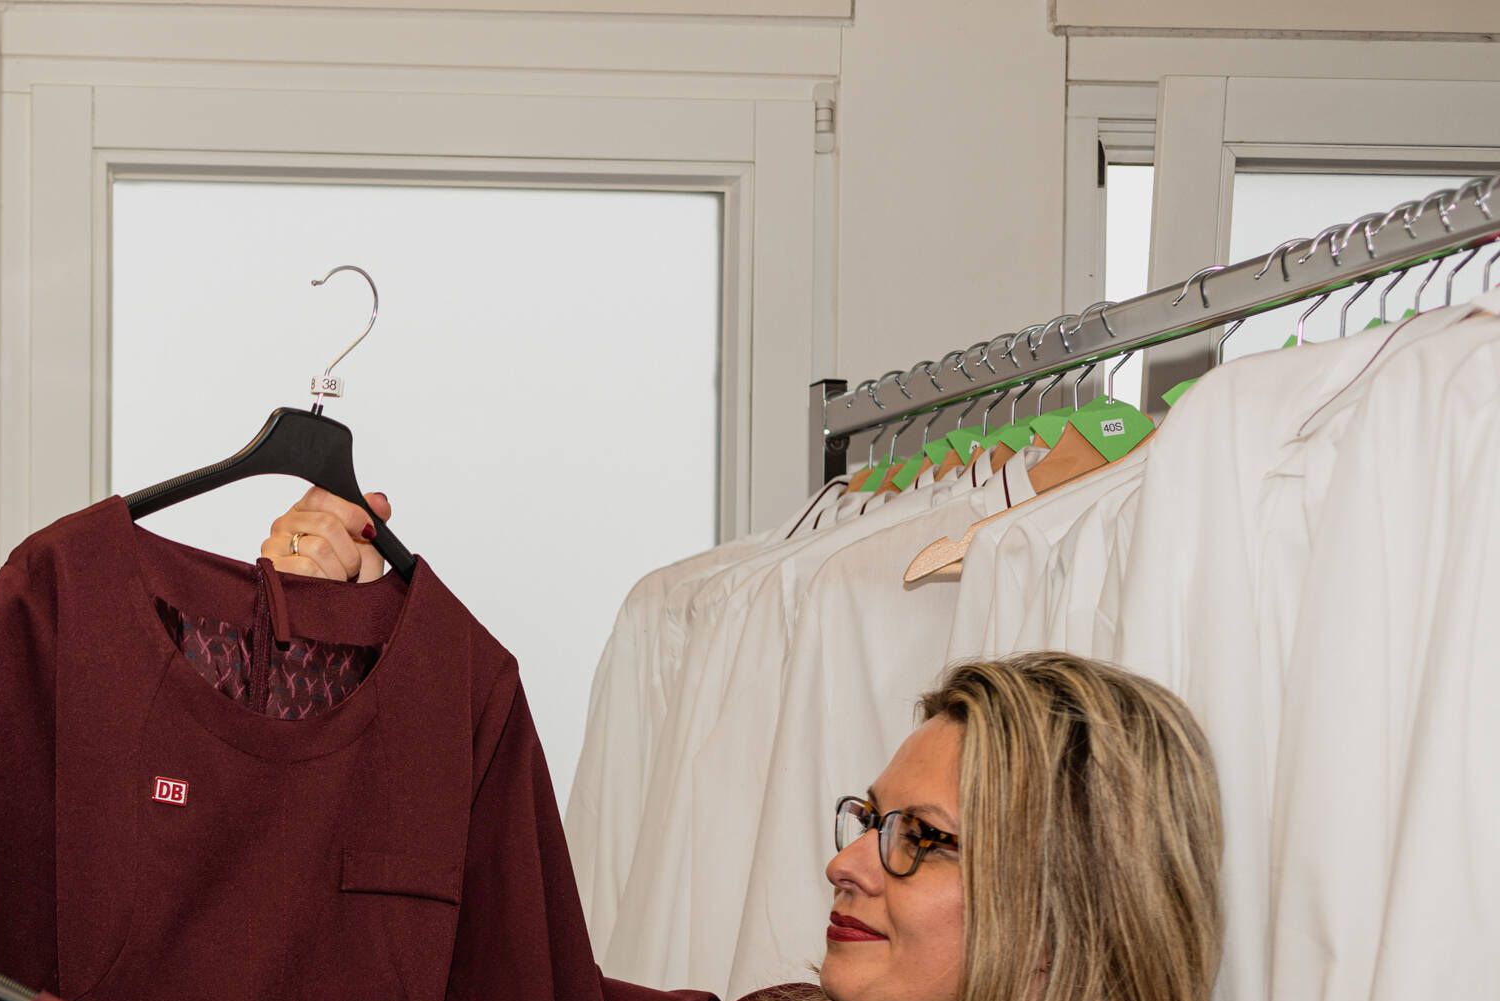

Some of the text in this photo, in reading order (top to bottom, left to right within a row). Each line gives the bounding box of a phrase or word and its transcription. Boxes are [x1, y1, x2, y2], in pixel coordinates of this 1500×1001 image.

[322, 378, 337, 391] 38
[1103, 422, 1123, 433] 40S
[157, 781, 184, 801] DB
